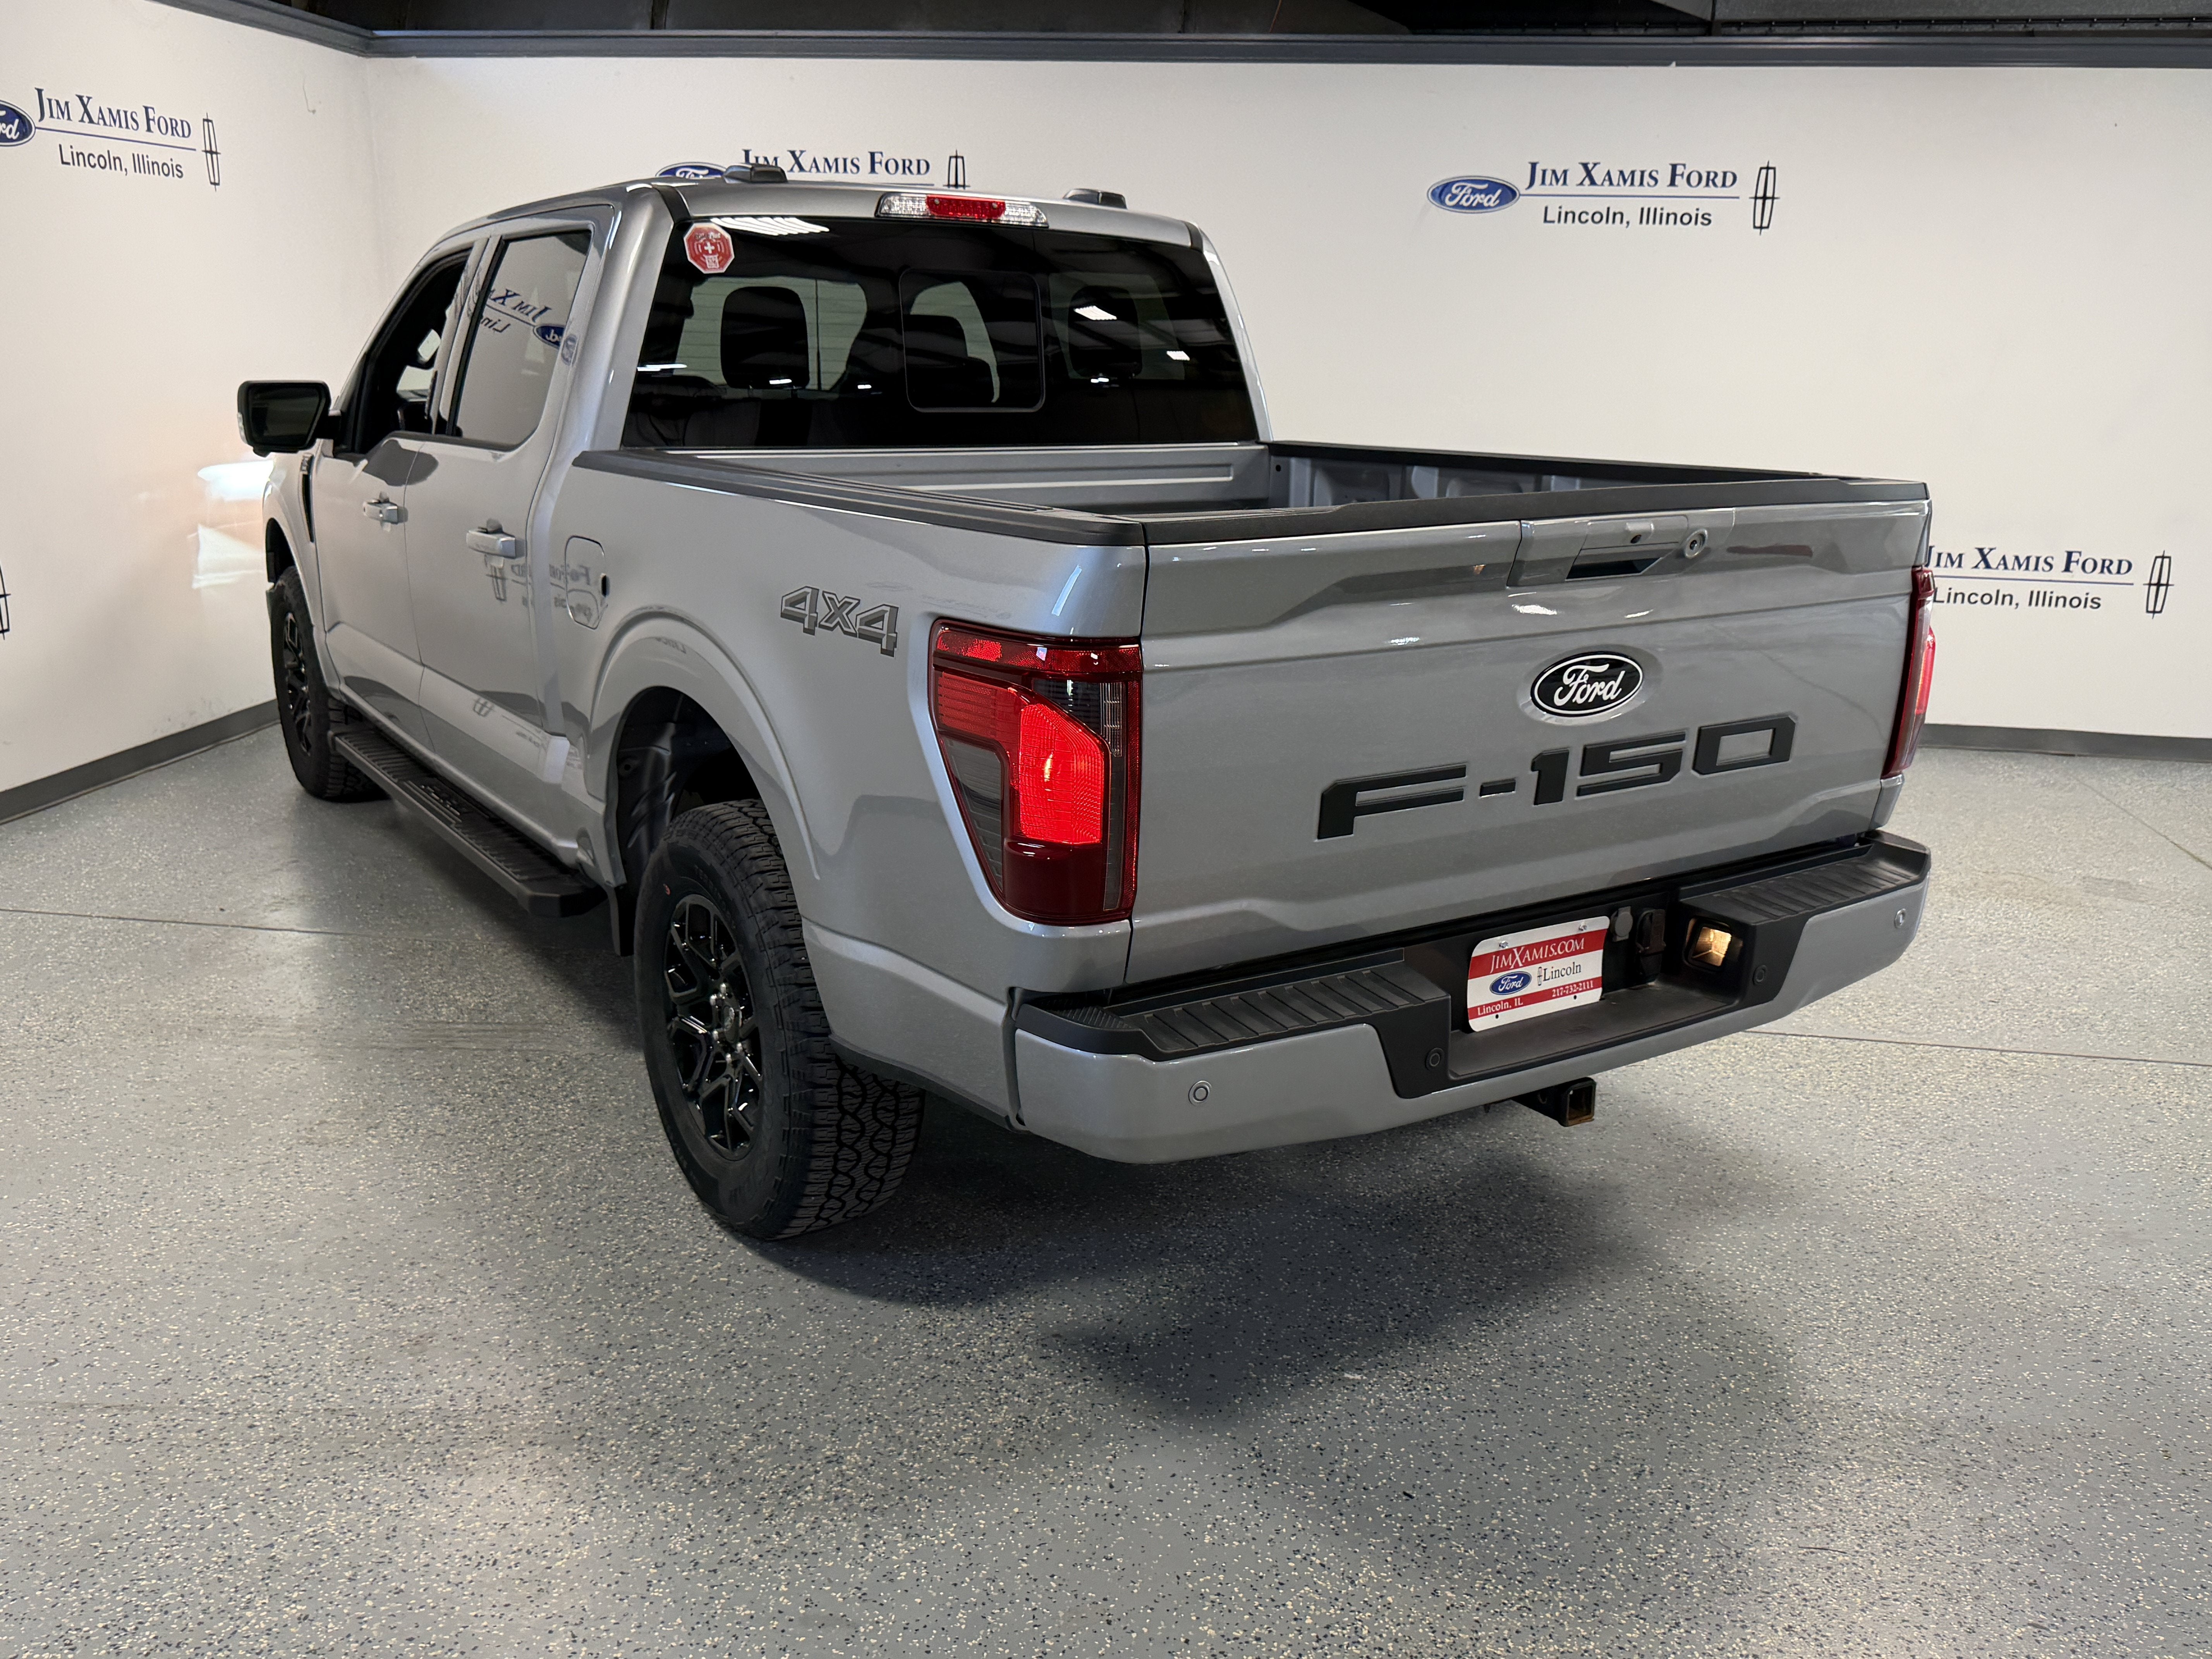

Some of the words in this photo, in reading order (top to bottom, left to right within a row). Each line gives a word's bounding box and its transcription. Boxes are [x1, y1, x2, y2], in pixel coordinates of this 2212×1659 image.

[35, 88, 72, 122] JIM
[75, 94, 139, 131] XAMIS
[143, 105, 191, 138] FORD
[59, 144, 128, 175] Lincoln,
[132, 153, 184, 179] Illinois
[787, 150, 860, 174] XAMIS
[868, 151, 930, 175] FORD
[1525, 161, 1568, 190] JIM
[1576, 162, 1659, 187] XAMIS
[1667, 163, 1737, 188] FORD
[1445, 182, 1500, 207] Ford
[1543, 206, 1630, 228] Lincoln,
[1639, 207, 1712, 226] Illinois
[1924, 545, 1965, 568] JIM
[1971, 547, 2054, 572] XAMIS
[2061, 551, 2133, 575] FORD
[1933, 587, 2019, 609] Lincoln,
[2028, 590, 2101, 609] Illinois
[1554, 663, 1625, 706] Ford
[1317, 713, 1796, 840] F-150
[1498, 975, 1523, 992] Ford
[1543, 962, 1582, 982] Lincoln
[1515, 998, 1523, 1006] IL
[1552, 984, 1594, 998] 217-732-2111
